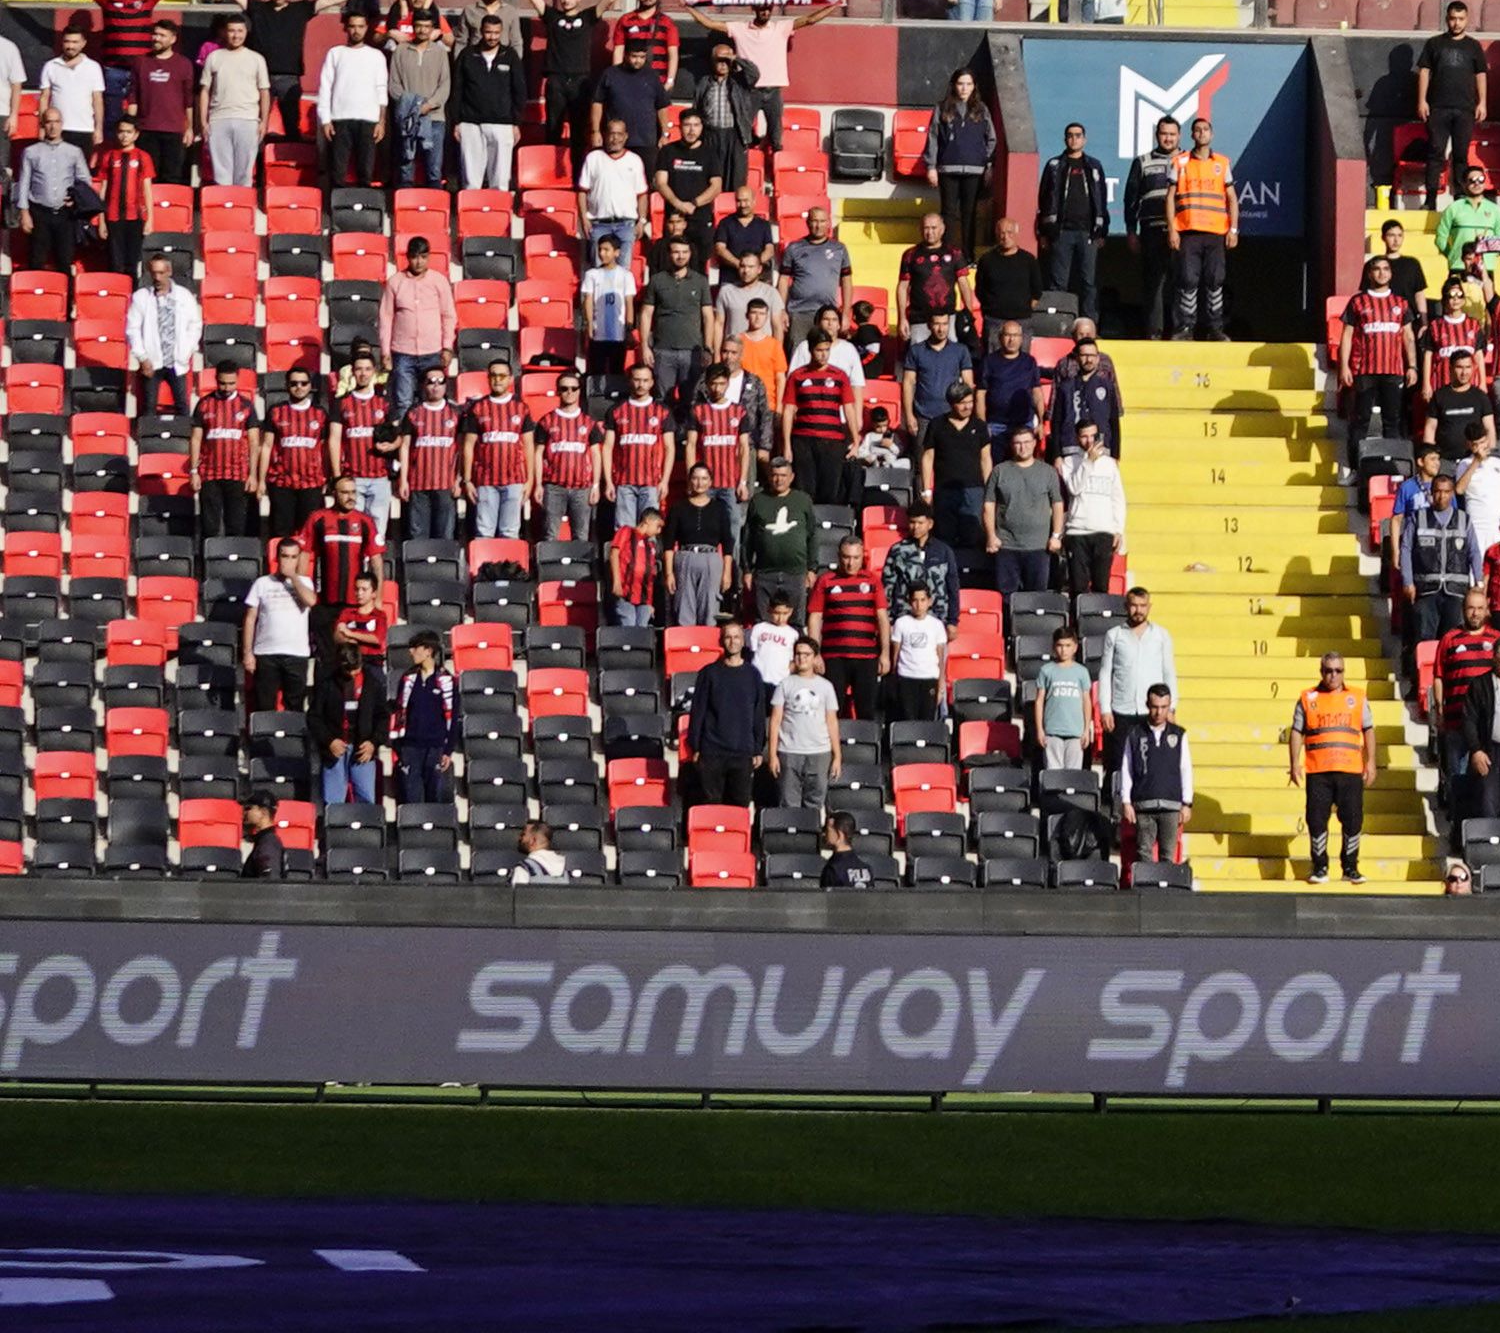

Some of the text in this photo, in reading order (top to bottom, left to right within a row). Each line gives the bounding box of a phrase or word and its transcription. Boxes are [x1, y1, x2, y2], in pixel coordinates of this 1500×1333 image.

[0, 932, 298, 1070] port
[455, 960, 1046, 1087] samuray
[1085, 945, 1460, 1086] sport
